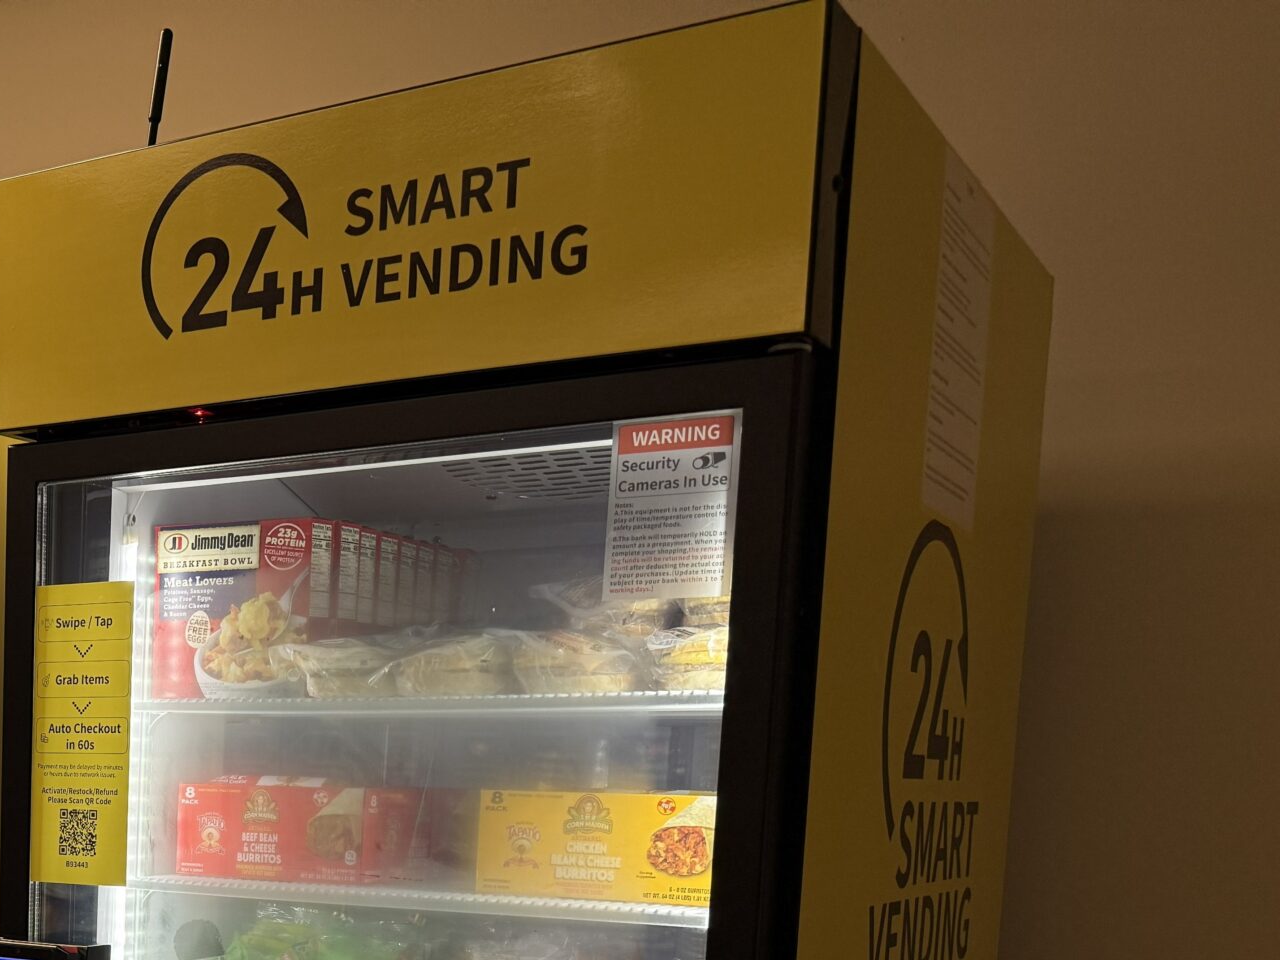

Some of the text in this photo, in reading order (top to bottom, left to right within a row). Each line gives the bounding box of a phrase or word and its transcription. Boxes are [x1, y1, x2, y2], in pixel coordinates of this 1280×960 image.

[344, 157, 531, 237] SMART
[181, 224, 588, 333] 24H VENDING
[632, 424, 720, 447] WARNING
[622, 456, 680, 472] Security
[619, 474, 728, 492] Cameras In Use
[278, 527, 298, 539] 23g
[661, 532, 698, 540] temporarily
[265, 537, 306, 548] PROTEIN
[163, 557, 253, 569] BREAKFAST BOWL
[163, 575, 234, 588] Meat Lovers
[55, 617, 86, 631] Swipe
[95, 616, 112, 629] Tap
[190, 618, 209, 627] CAGE
[188, 626, 208, 636] FREE
[187, 634, 208, 644] EGGS
[55, 673, 109, 686] Grab Items
[49, 723, 121, 734] Auto Checkout
[66, 739, 95, 750] in 60s
[42, 787, 118, 796] Activate/Restock/Refund
[185, 786, 195, 798] 8
[491, 791, 504, 804] 8
[47, 796, 67, 804] Please
[68, 797, 83, 805] Scan
[85, 797, 94, 805] QR
[241, 832, 278, 843] BEEF BEAN
[250, 843, 276, 854] CHEESE
[566, 842, 607, 854] CHICKEN
[895, 801, 980, 890] SMART
[237, 852, 282, 864] BURRITOS
[551, 855, 577, 866] BEAN
[587, 855, 622, 867] CHEESE
[555, 869, 615, 881] BURRITOS
